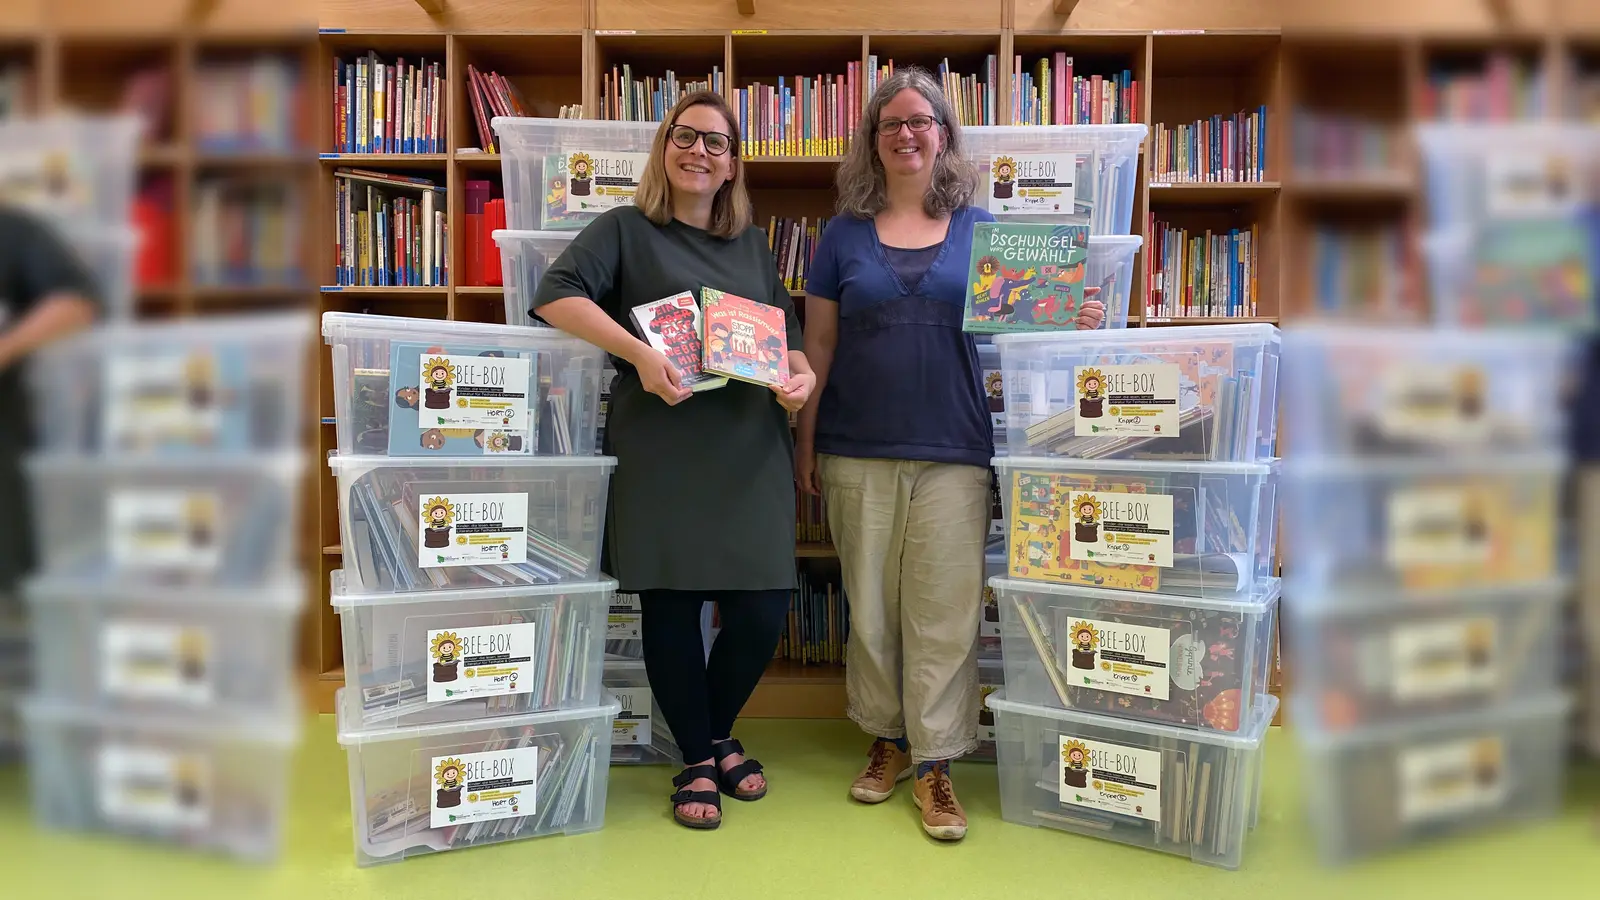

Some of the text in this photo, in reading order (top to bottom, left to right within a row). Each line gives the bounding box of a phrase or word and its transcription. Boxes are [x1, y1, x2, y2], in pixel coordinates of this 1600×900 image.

[594, 159, 634, 176] BEE-BOX
[1018, 161, 1056, 177] BEE-BOX
[990, 234, 1076, 248] DSCHUNGEL
[1004, 247, 1076, 264] GEWÄHLT
[711, 311, 728, 319] Was
[678, 354, 699, 365] MIR
[457, 365, 505, 385] BEE-BOX
[1108, 374, 1155, 392] BEE-BOX
[456, 502, 504, 522] BEE-BOX
[1103, 502, 1149, 521] BEE-BOX
[464, 633, 511, 654] BEE-BOX
[1100, 630, 1146, 653] BEE-BOX
[467, 758, 514, 780] BEE-BOX
[1092, 750, 1138, 774] BEE-BOX
